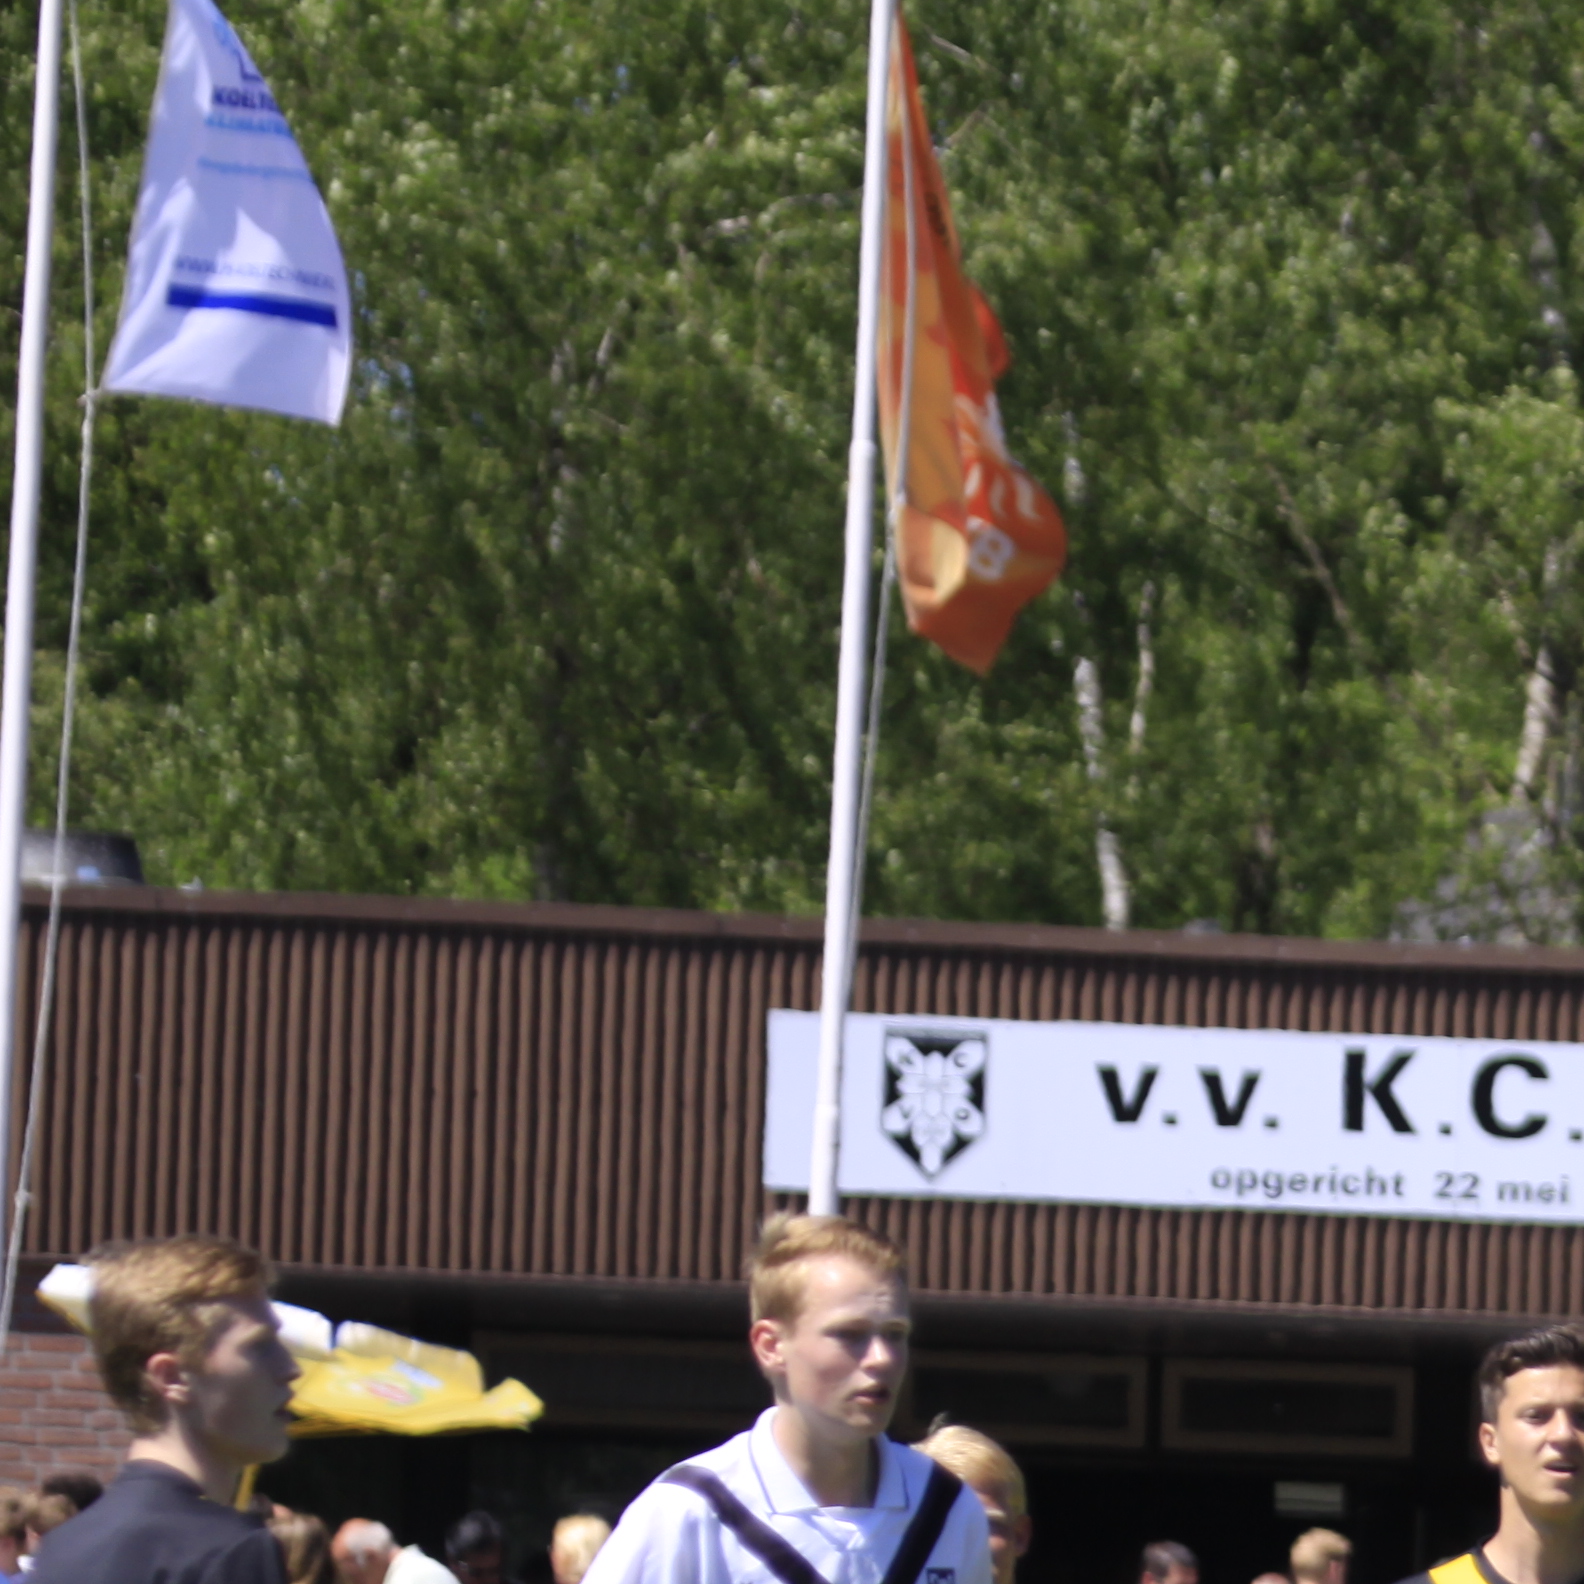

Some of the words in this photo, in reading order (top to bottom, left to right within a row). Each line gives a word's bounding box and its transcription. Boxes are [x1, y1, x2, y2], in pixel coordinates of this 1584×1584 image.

[1097, 1063, 1280, 1129] v.v.
[1211, 1167, 1405, 1198] opgericht
[1434, 1172, 1480, 1199] 22
[1498, 1175, 1570, 1203] mei
